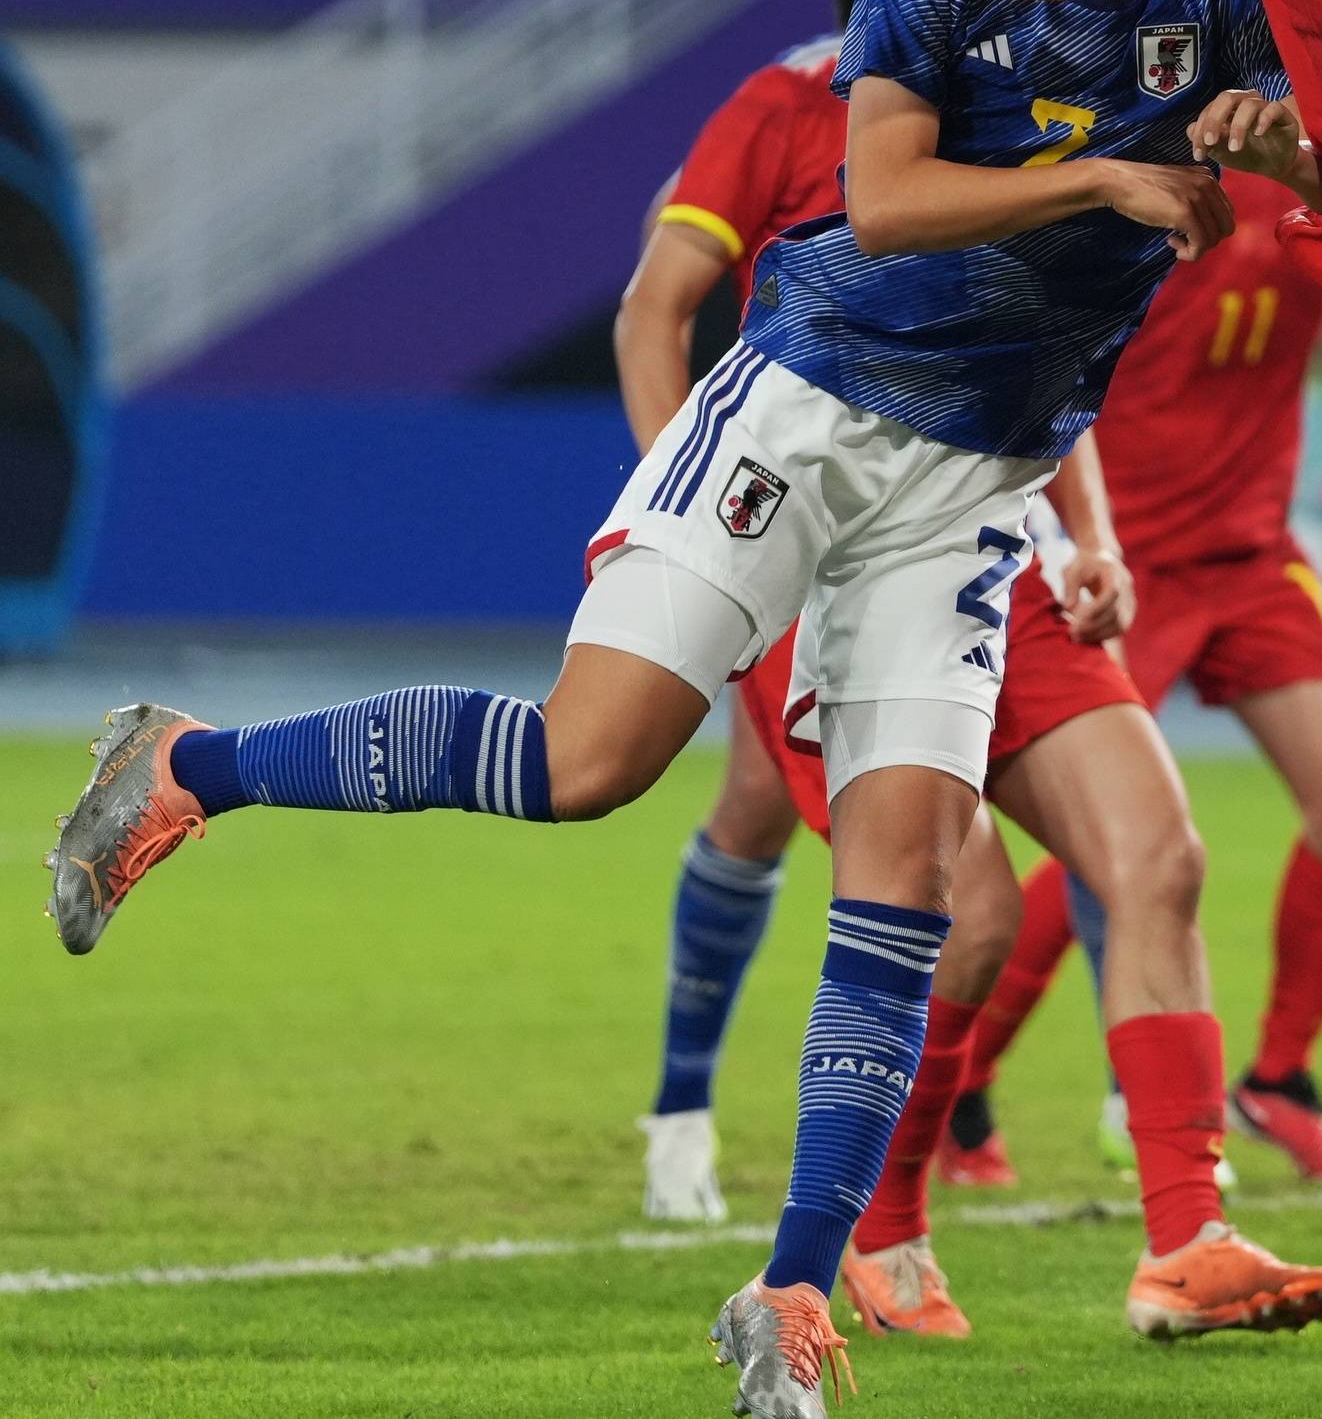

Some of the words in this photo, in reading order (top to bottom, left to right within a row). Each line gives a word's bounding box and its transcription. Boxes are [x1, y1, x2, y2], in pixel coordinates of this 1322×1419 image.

[1152, 26, 1184, 35] JAPAN
[1208, 286, 1278, 367] 11
[751, 464, 780, 486] JAPAN
[956, 526, 1026, 629] 2
[367, 719, 393, 812] JAPA
